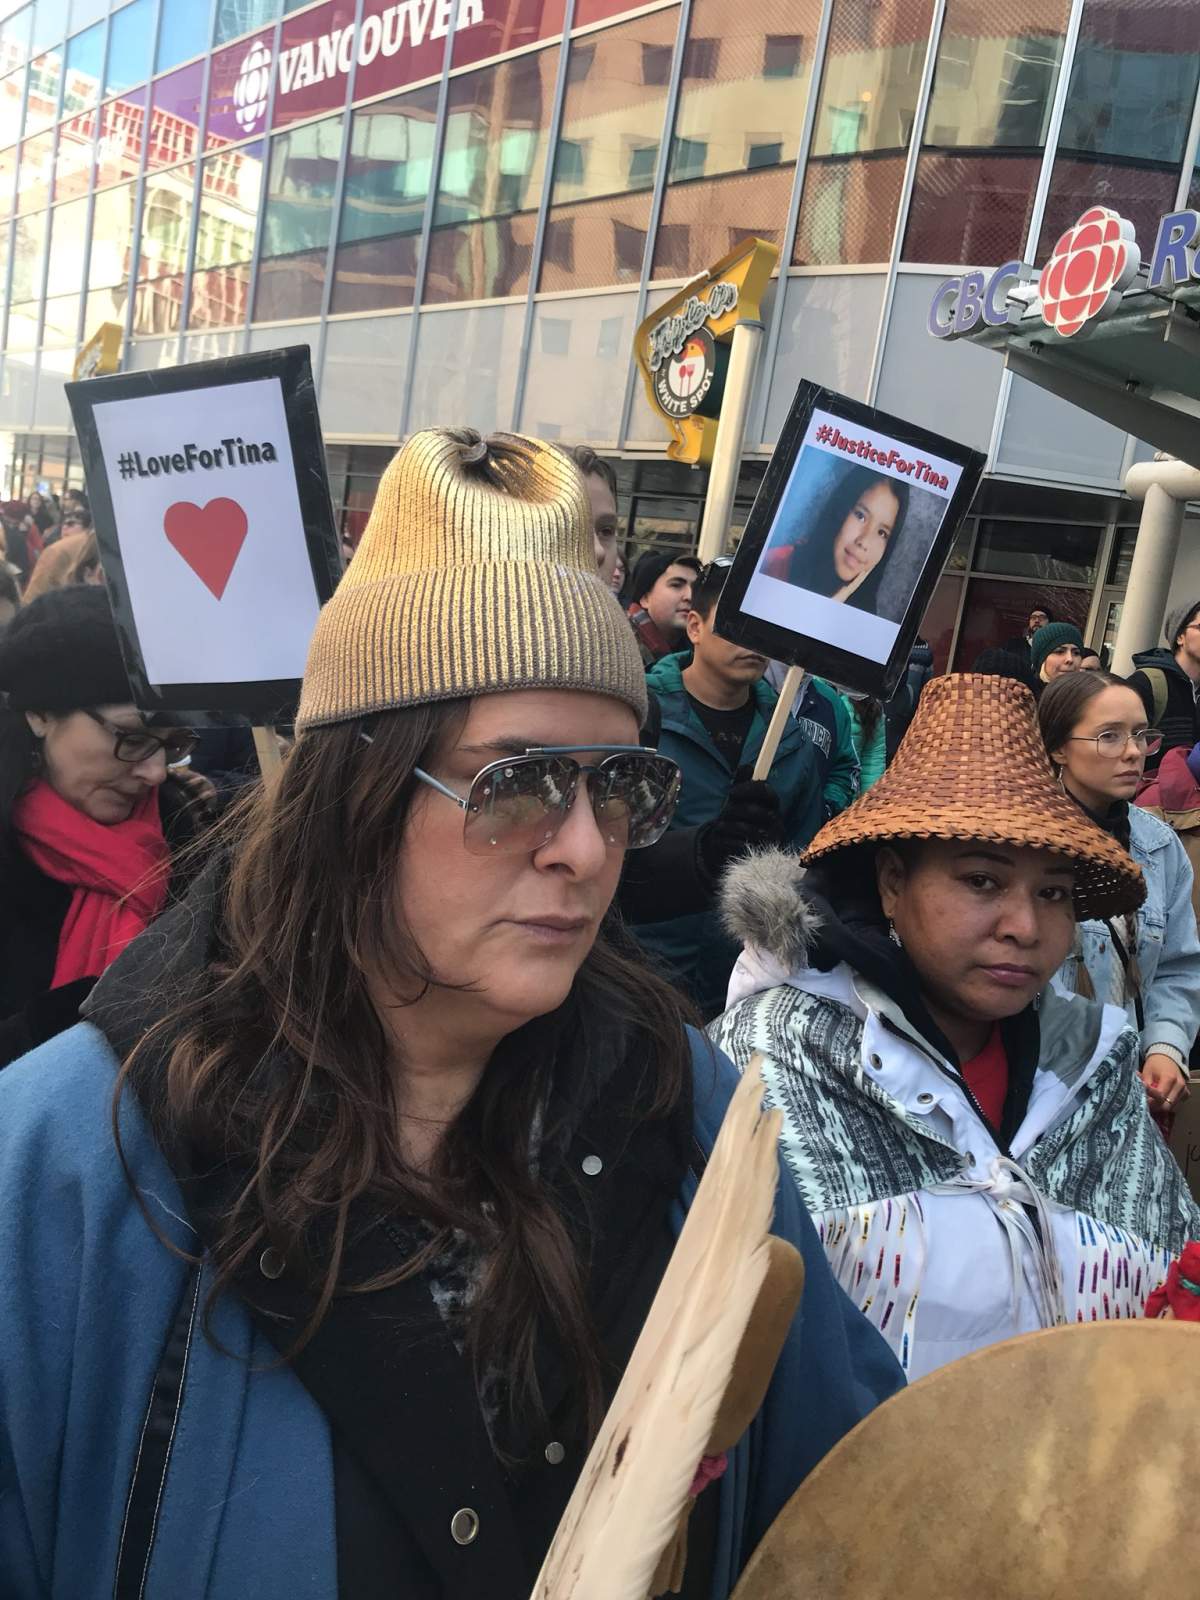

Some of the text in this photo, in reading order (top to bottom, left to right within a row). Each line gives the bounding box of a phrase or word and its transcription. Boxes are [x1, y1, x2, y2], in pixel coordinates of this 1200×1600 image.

[278, 0, 484, 95] VANCOUVER
[1147, 209, 1200, 290] R
[927, 260, 1030, 339] CBC
[657, 368, 715, 413] WHITE SPOT
[117, 437, 278, 480] #LoveForTina
[816, 424, 949, 491] #JusticeForTina
